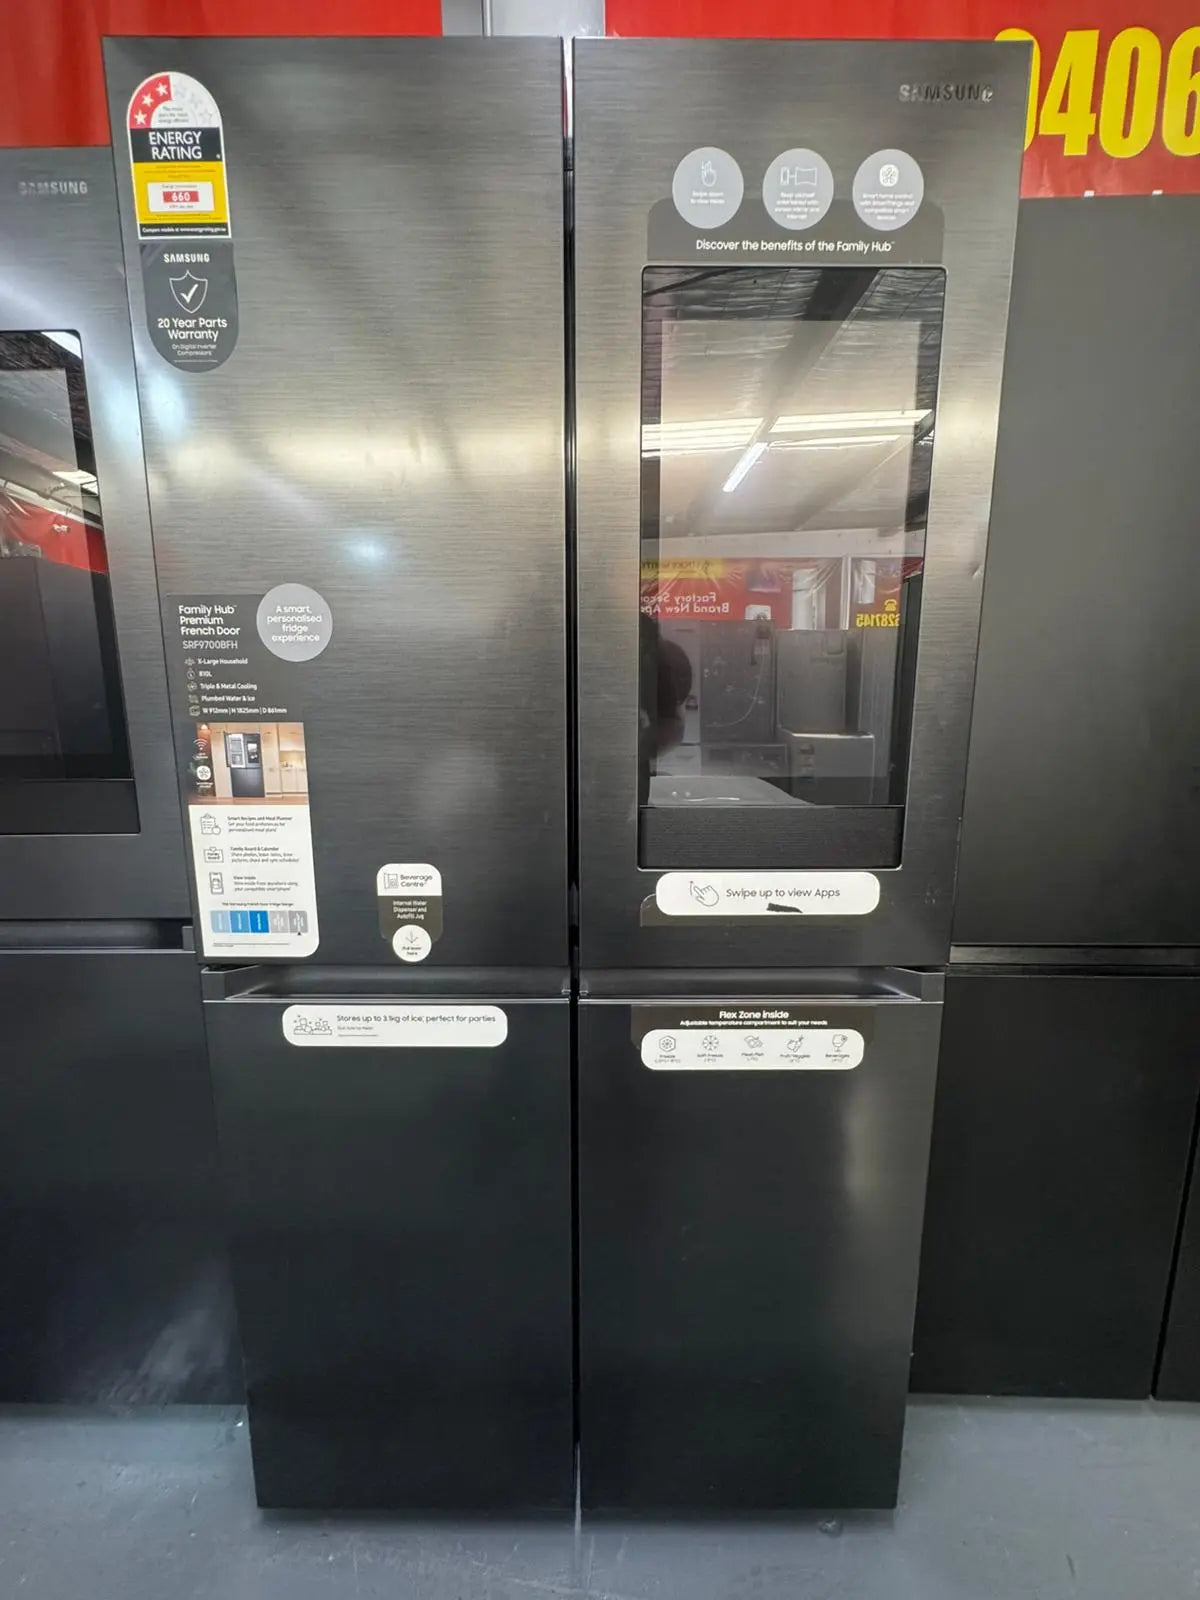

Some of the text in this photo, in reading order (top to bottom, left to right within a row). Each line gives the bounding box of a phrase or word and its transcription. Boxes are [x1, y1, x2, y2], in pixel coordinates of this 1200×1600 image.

[899, 84, 993, 103] SAMSUNG
[148, 131, 202, 146] ENERGY
[151, 146, 203, 160] RATING
[18, 181, 88, 195] SAMSUNG
[172, 191, 191, 202] 660
[696, 238, 740, 250] Discover
[742, 240, 759, 251] the
[760, 240, 804, 251] benefits
[804, 240, 816, 251] of
[818, 241, 835, 252] the
[836, 240, 870, 255] Family
[163, 253, 210, 264] SAMSUNG
[157, 318, 228, 329] 20 Year Parts
[168, 329, 219, 343] Warranty
[178, 605, 213, 617] Family
[276, 606, 282, 614] A
[180, 616, 224, 625] Premium
[267, 615, 322, 625] personalised
[180, 626, 241, 636] French Door
[282, 624, 308, 635] fridge
[182, 640, 238, 650] SRF9700BFH
[272, 635, 320, 644] experience
[237, 683, 258, 691] Cooling
[726, 888, 840, 900] Swipe up to view Apps
[426, 1015, 455, 1024] perfect
[468, 1015, 496, 1024] parties
[720, 1011, 738, 1019] Flex
[738, 1011, 761, 1019] Zone
